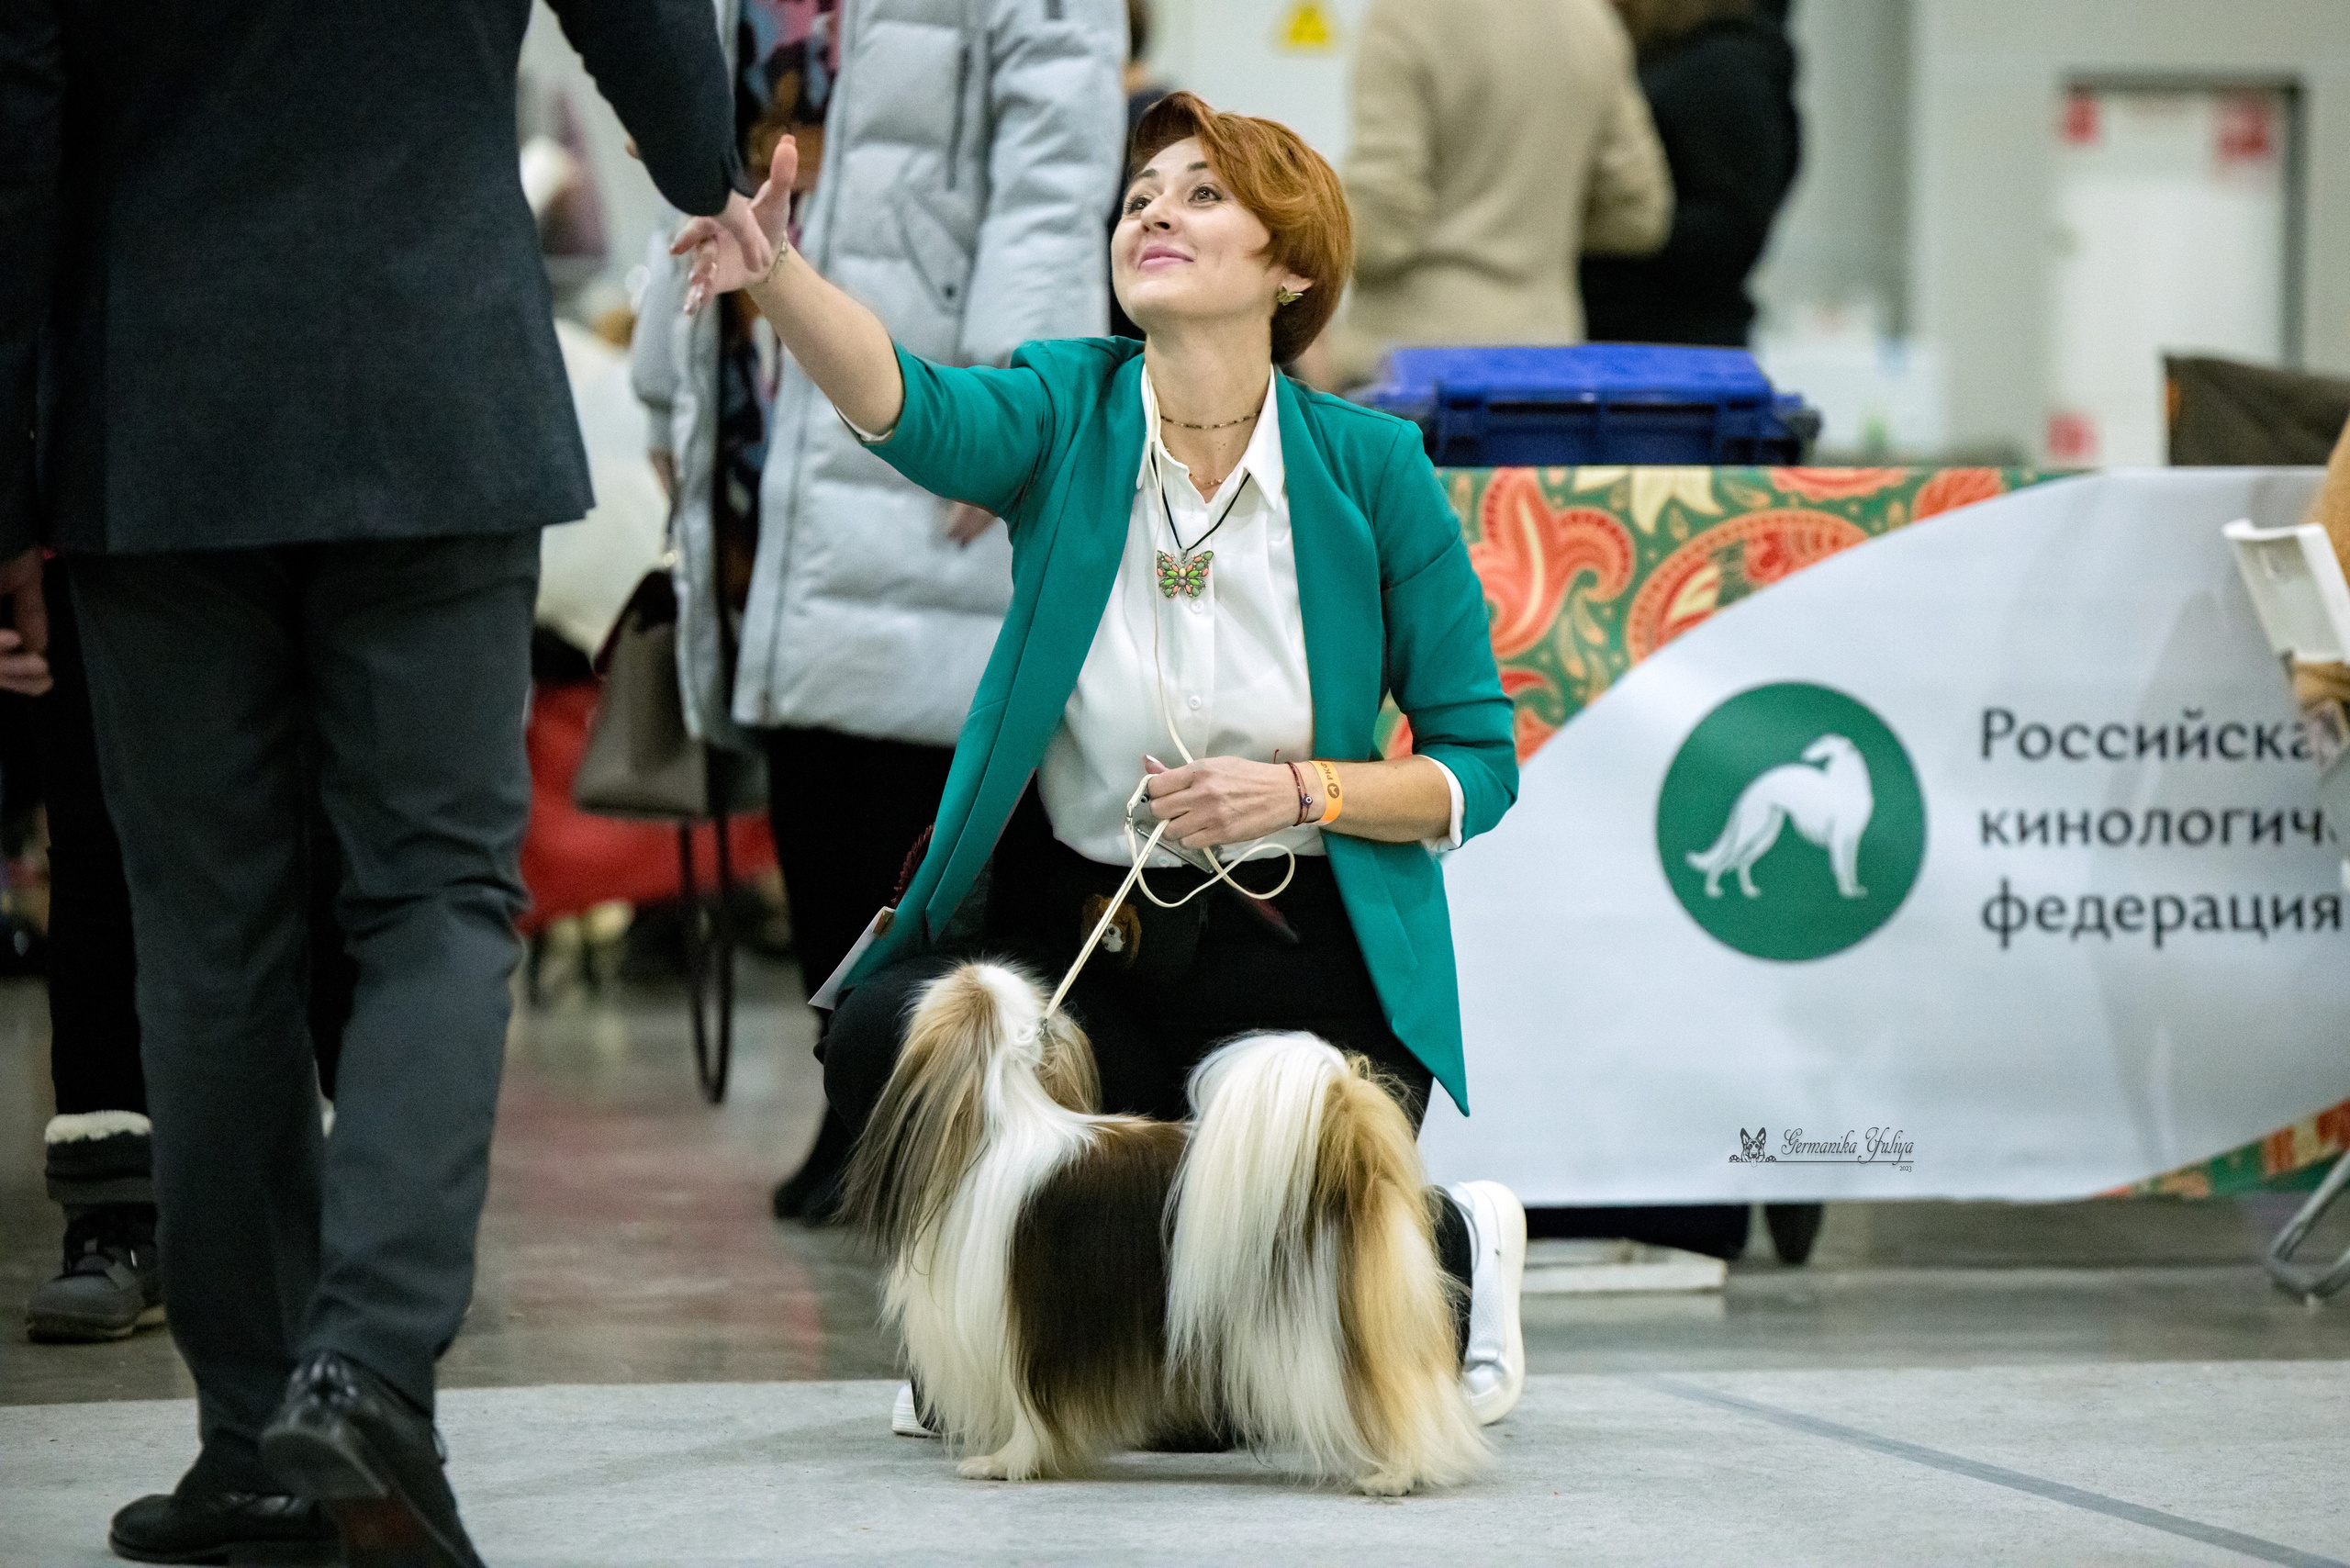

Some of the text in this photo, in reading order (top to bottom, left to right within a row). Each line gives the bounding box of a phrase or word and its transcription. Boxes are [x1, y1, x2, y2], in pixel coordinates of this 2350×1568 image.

[1980, 707, 2313, 761] Российска
[1980, 809, 2336, 846] кинологич
[1980, 876, 2342, 950] федерация
